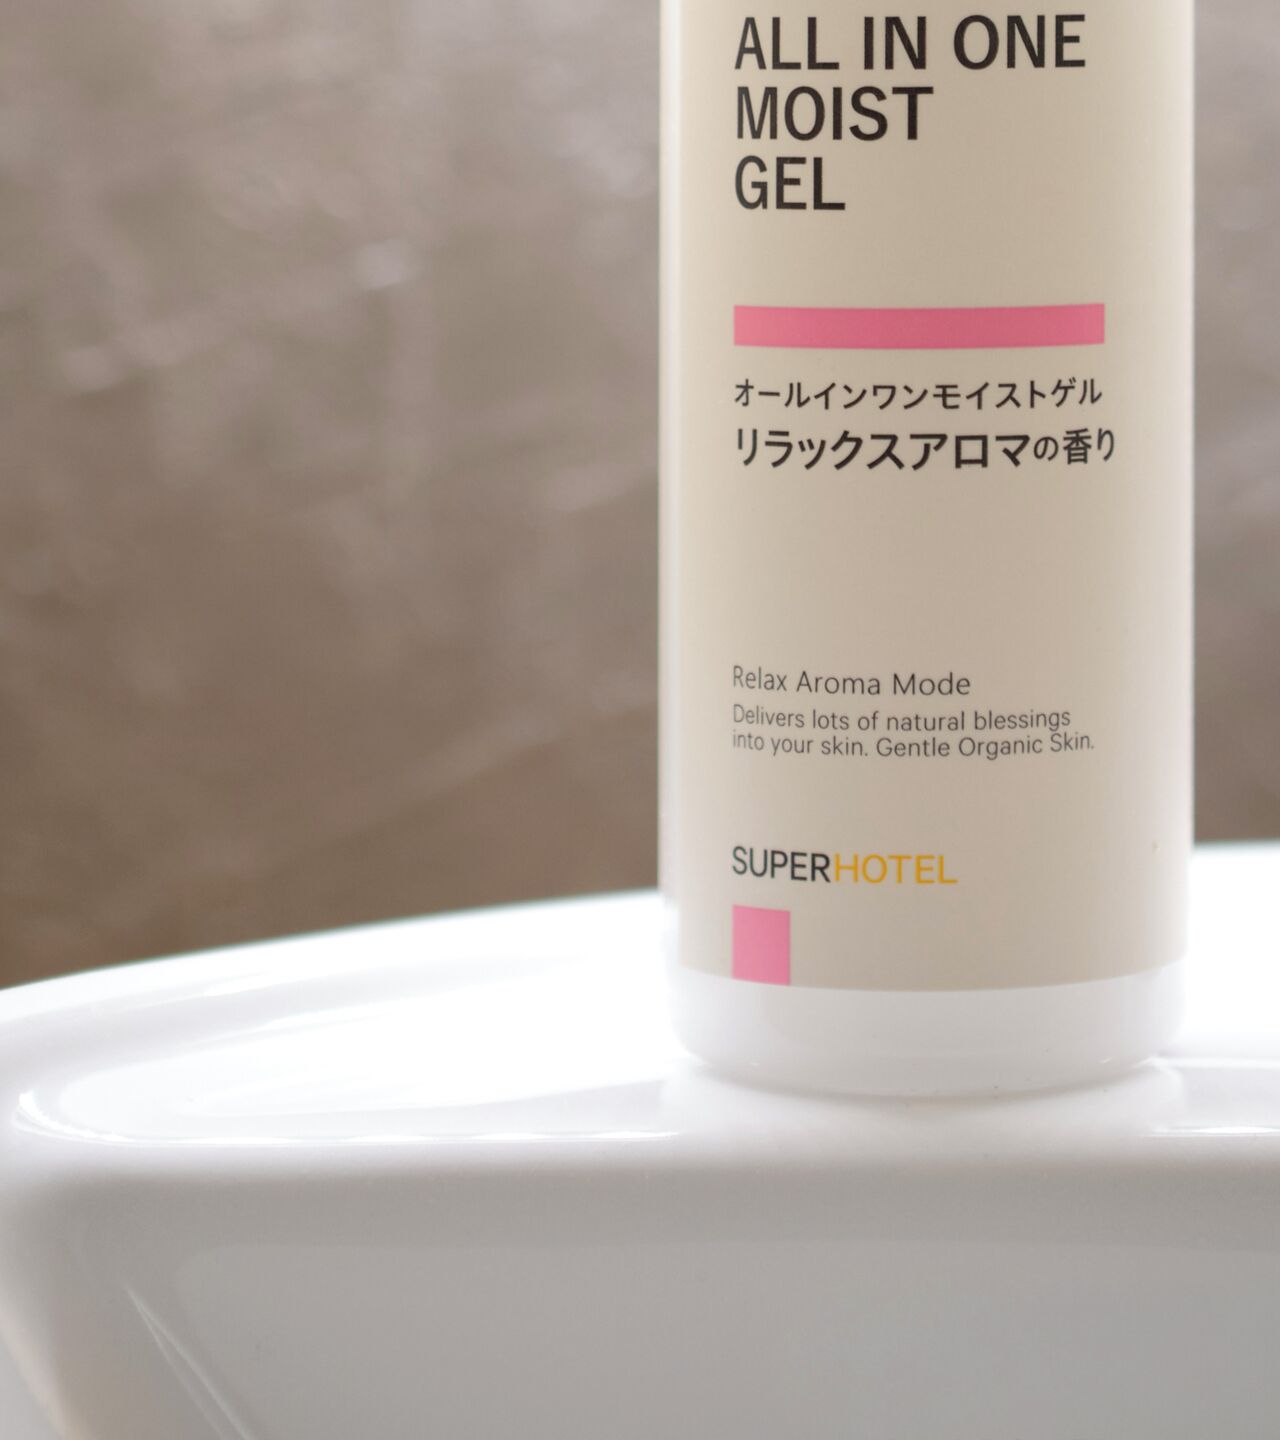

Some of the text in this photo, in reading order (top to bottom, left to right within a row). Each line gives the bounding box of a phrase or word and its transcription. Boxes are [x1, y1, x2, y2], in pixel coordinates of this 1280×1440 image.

[734, 14, 1085, 70] ALL IN ONE
[737, 86, 934, 141] MOIST
[735, 155, 845, 210] GEL
[734, 377, 1102, 410] オールインワンモイストゲル
[737, 427, 1114, 470] リラックスアロマの香り
[732, 665, 971, 696] Relax Aroma Mode
[733, 703, 1070, 732] Delivers lots of natural blessings
[732, 730, 1094, 760] into your skin. Gentle Organic Skin.
